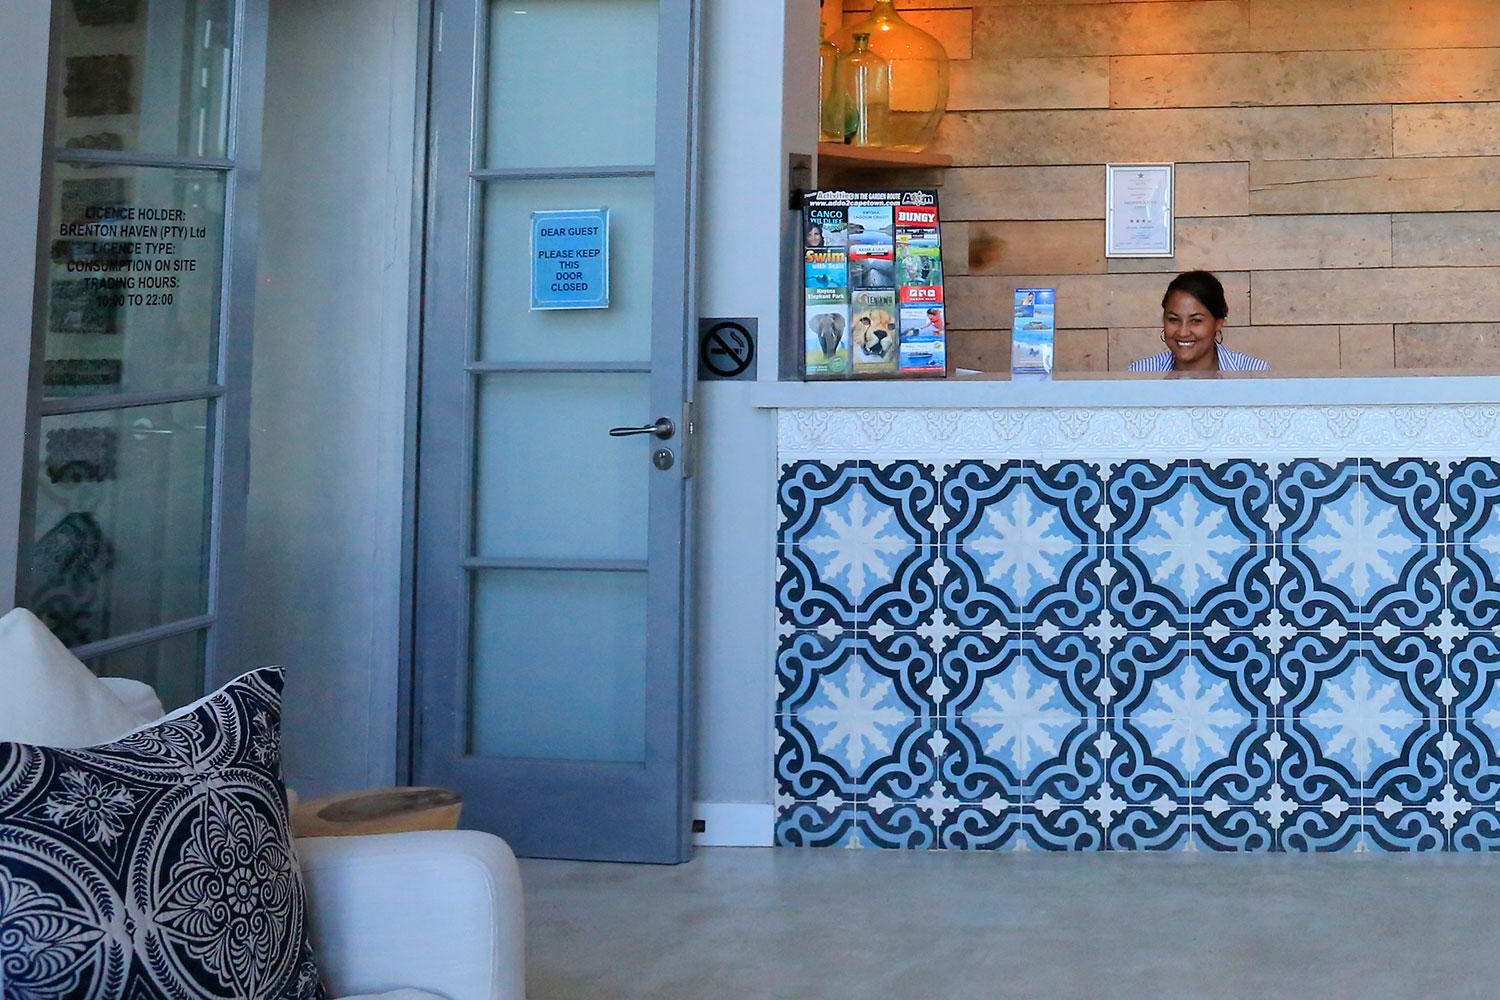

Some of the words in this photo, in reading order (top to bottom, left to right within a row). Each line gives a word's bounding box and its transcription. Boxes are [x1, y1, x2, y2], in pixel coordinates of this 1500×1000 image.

[85, 207, 135, 221] LICENCE
[138, 208, 187, 222] HOLDER:
[811, 210, 843, 218] CANGO
[898, 211, 936, 223] BUNGY
[59, 223, 117, 238] BRENTON
[120, 225, 158, 238] HAVEN
[160, 226, 188, 240] (PTY)
[190, 227, 206, 239] Ltd
[541, 228, 565, 237] DEAR
[568, 227, 598, 236] GUEST
[93, 242, 142, 255] LICENCE
[144, 242, 176, 255] TYPE:
[538, 250, 573, 259] PLEASE
[576, 249, 600, 258] KEEP
[805, 249, 845, 263] Swim
[67, 259, 152, 272] CONSUMPTION
[155, 259, 171, 272] ON
[173, 259, 197, 272] SITE
[559, 261, 579, 269] THIS
[556, 272, 582, 280] DOOR
[84, 277, 135, 290] TRADING
[138, 276, 180, 289] HOURS:
[551, 283, 588, 291] CLOSED
[128, 294, 144, 306] TO
[145, 293, 174, 306] 22:00
